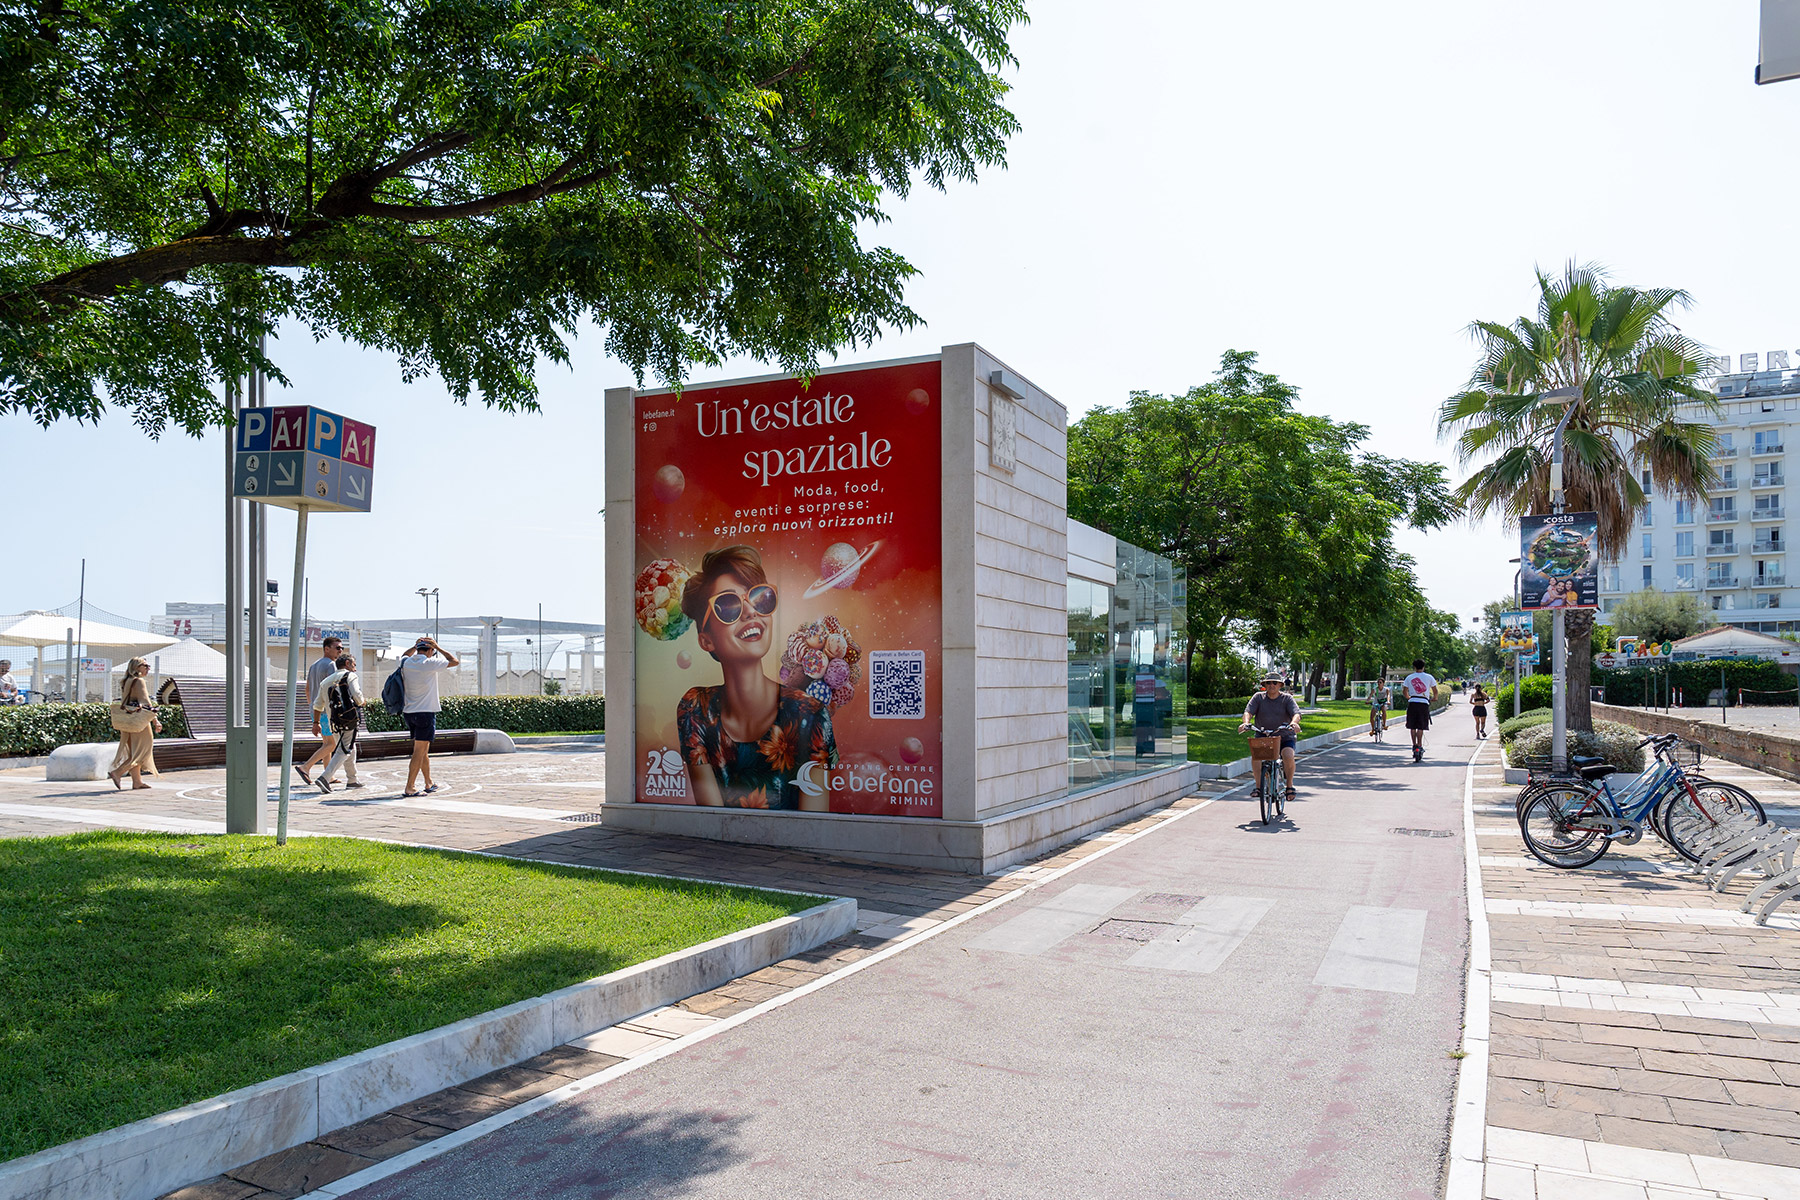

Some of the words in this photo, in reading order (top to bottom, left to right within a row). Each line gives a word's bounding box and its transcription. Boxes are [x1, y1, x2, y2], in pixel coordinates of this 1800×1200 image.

[642, 408, 675, 420] lebefane.it
[695, 391, 855, 437] Un'estate
[243, 412, 266, 448] P
[272, 416, 303, 448] A1
[314, 413, 337, 450] P
[343, 429, 371, 465] A1
[741, 431, 893, 487] spaziale
[794, 483, 838, 498] Moda,
[844, 479, 884, 494] food,
[734, 503, 779, 518] eventi
[785, 505, 792, 515] e
[798, 499, 870, 515] sorprese:
[713, 521, 767, 537] esplora
[772, 516, 813, 532] nuovi
[818, 511, 894, 529] orizzonti!
[1546, 514, 1574, 524] costa
[173, 619, 192, 635] 75
[1623, 641, 1672, 658] PACO
[1628, 656, 1670, 667] BEACH
[823, 763, 881, 771] SHOPPING
[645, 775, 686, 789] ANNI
[645, 788, 686, 798] GALATTICI
[890, 796, 934, 806] RIMINI
